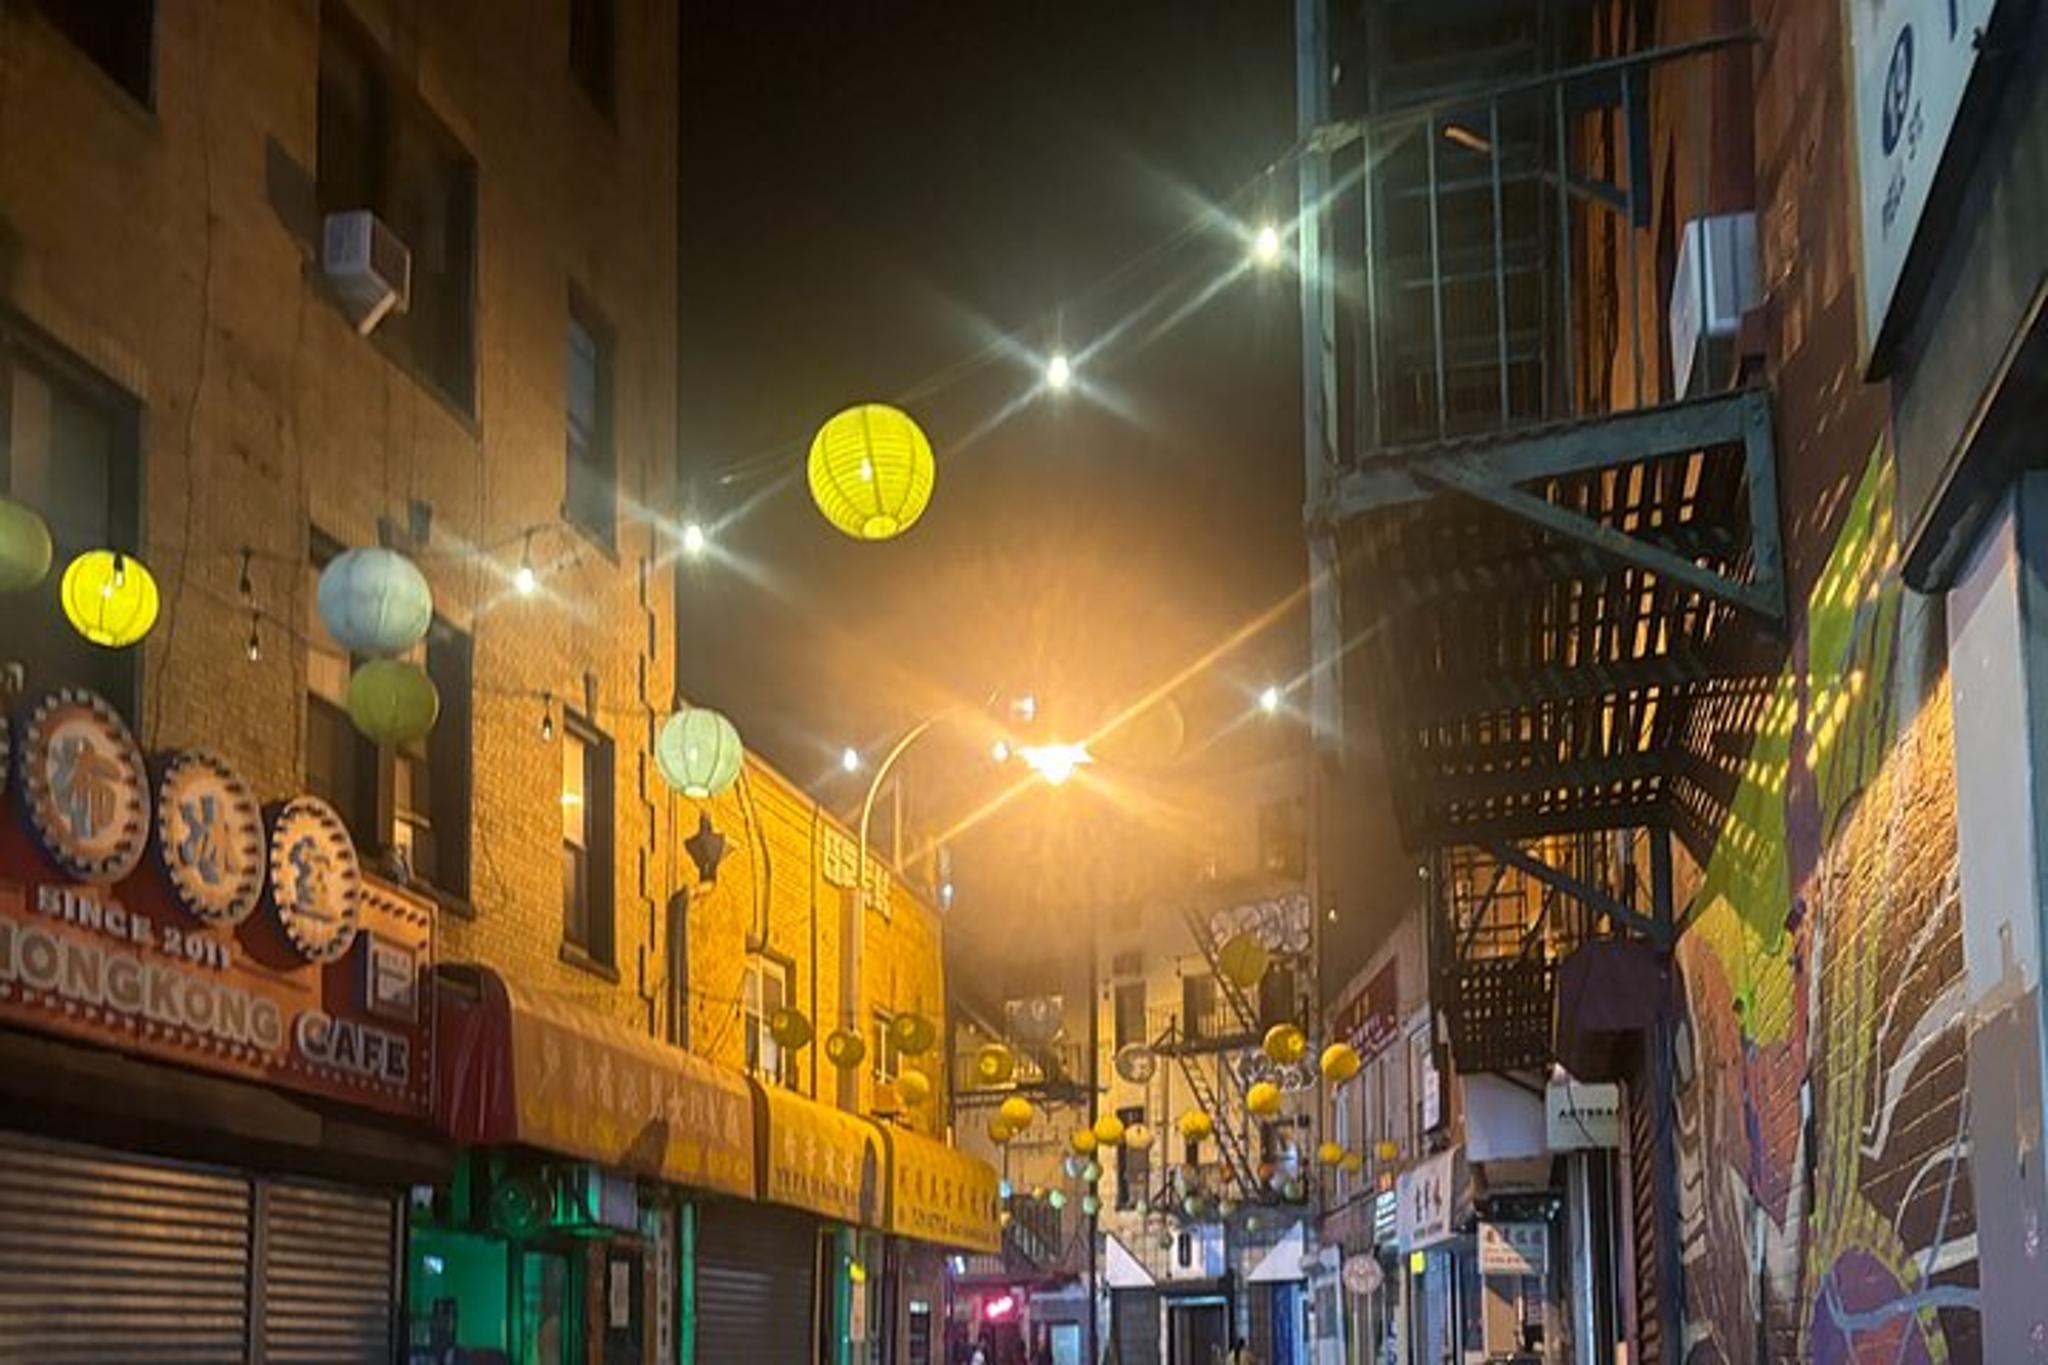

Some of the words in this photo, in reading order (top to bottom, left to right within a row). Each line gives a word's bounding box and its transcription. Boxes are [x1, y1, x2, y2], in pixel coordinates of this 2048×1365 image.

[38, 884, 154, 944] SINCE
[163, 926, 231, 970] 2011
[297, 1011, 411, 1085] CAFE
